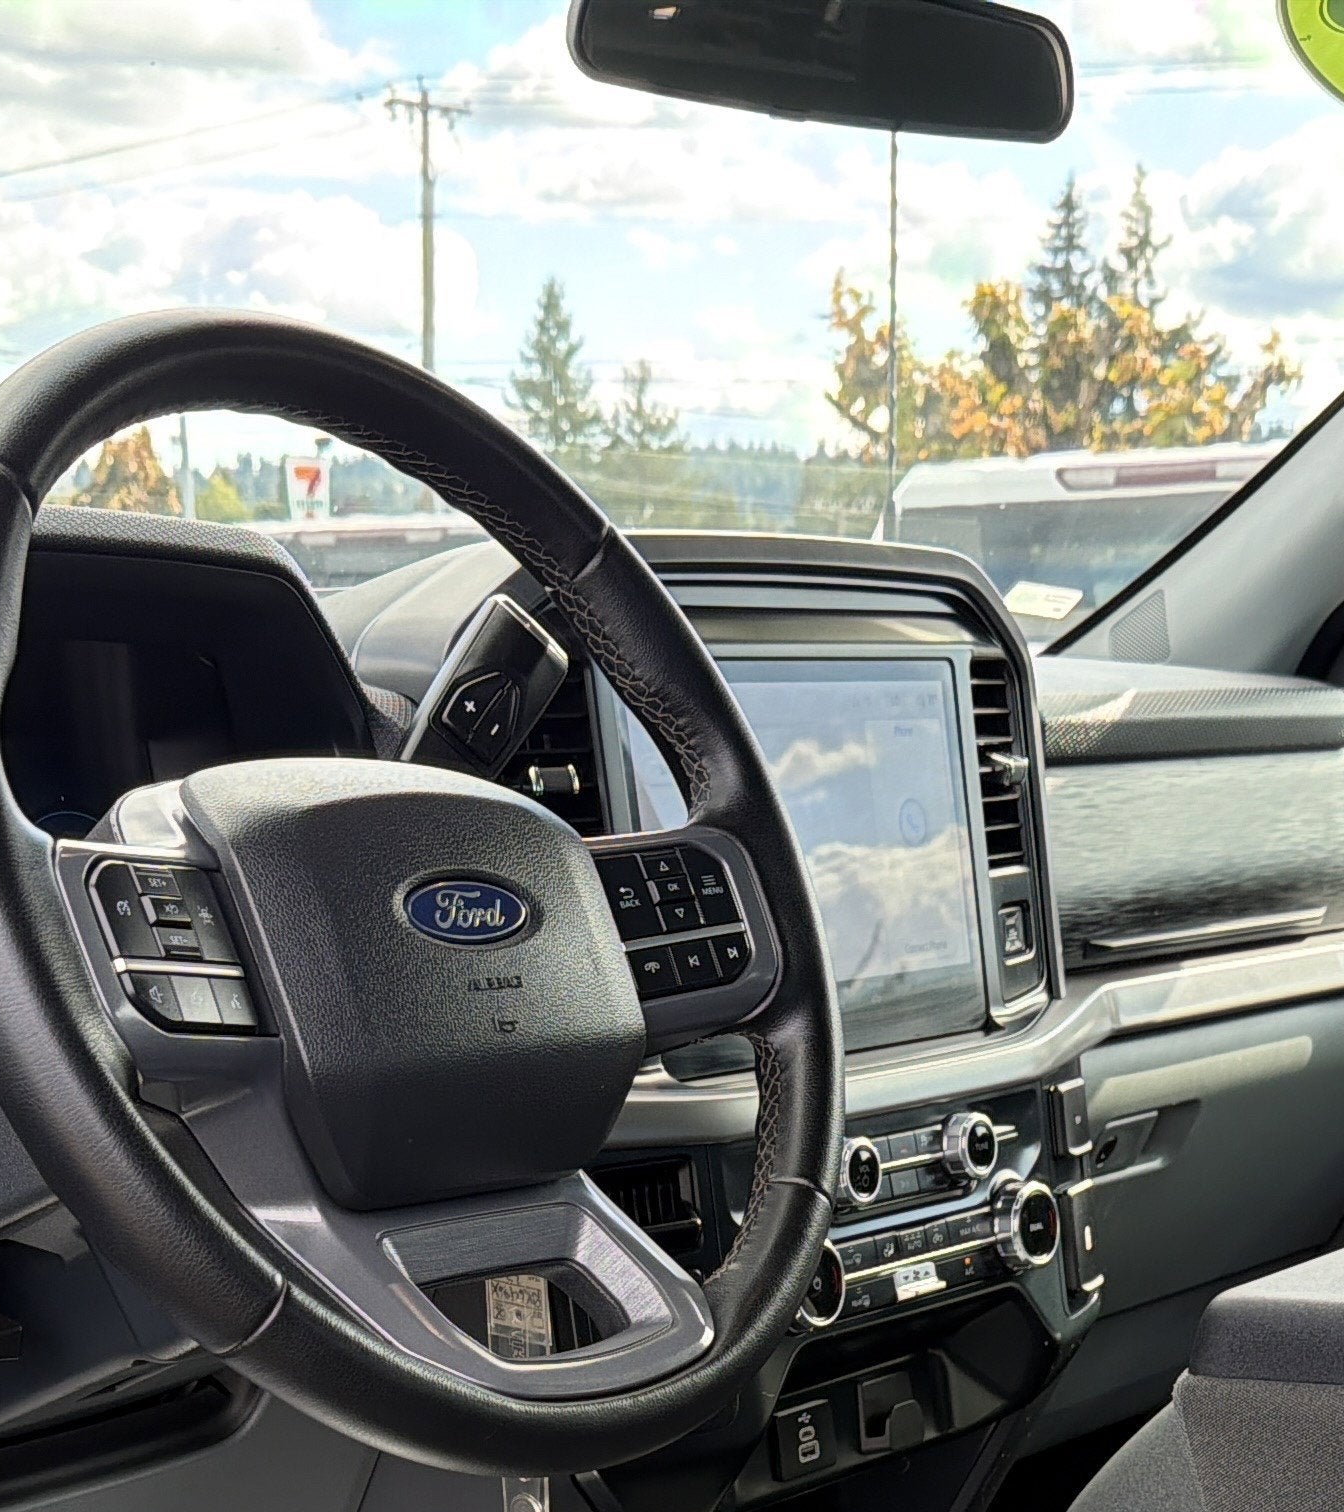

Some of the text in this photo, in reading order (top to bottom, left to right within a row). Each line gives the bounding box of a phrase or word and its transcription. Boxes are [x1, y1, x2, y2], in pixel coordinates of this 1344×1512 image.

[667, 883, 680, 892] OK
[701, 886, 723, 896] MENU
[619, 899, 641, 909] BACK
[434, 889, 506, 930] Ford
